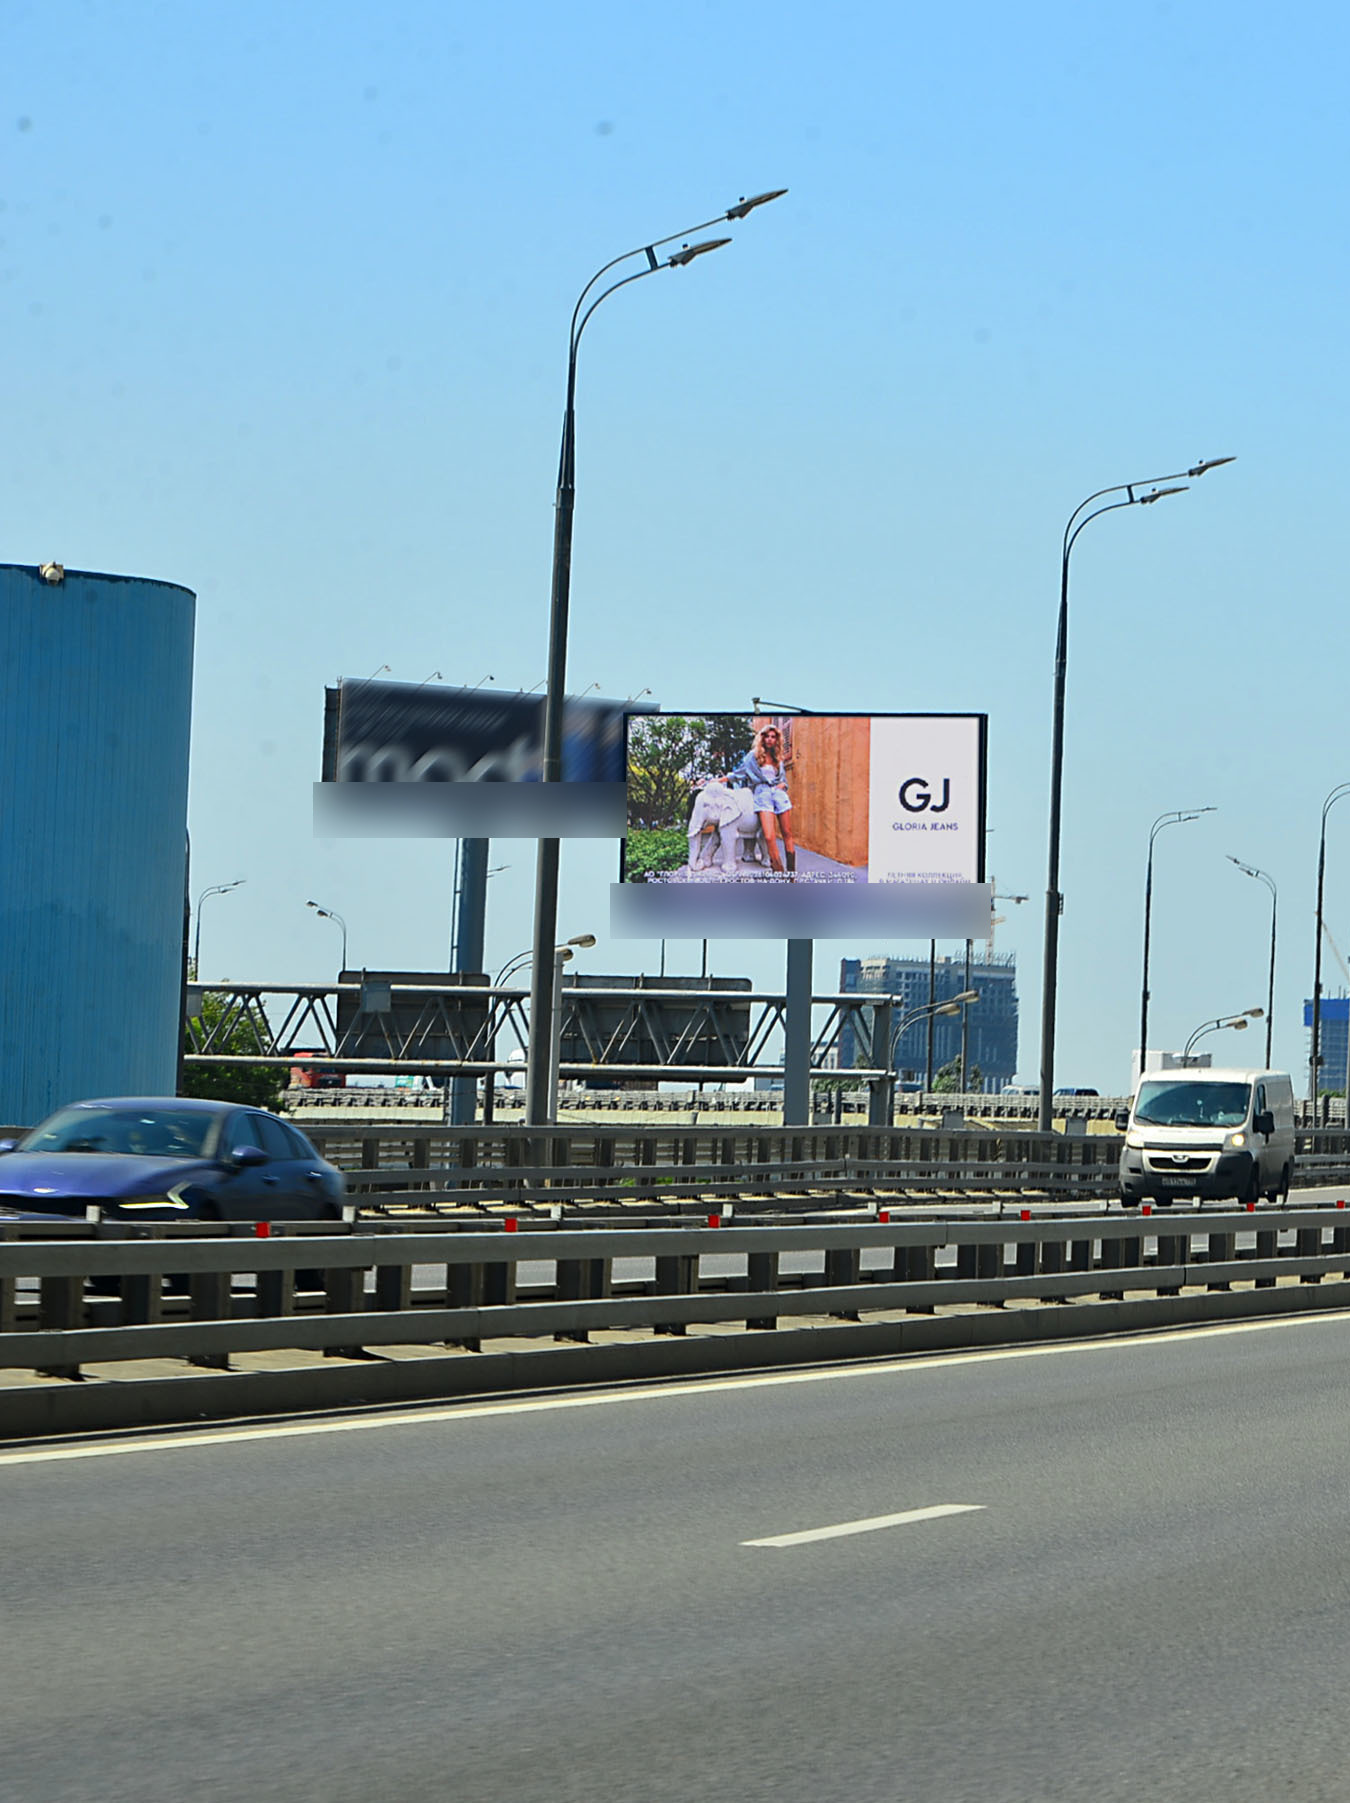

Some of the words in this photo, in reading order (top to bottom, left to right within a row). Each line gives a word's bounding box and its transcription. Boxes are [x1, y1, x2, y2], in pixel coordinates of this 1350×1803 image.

[898, 776, 950, 813] GJ
[892, 822, 927, 831] GLORIA
[930, 822, 959, 831] JEANS
